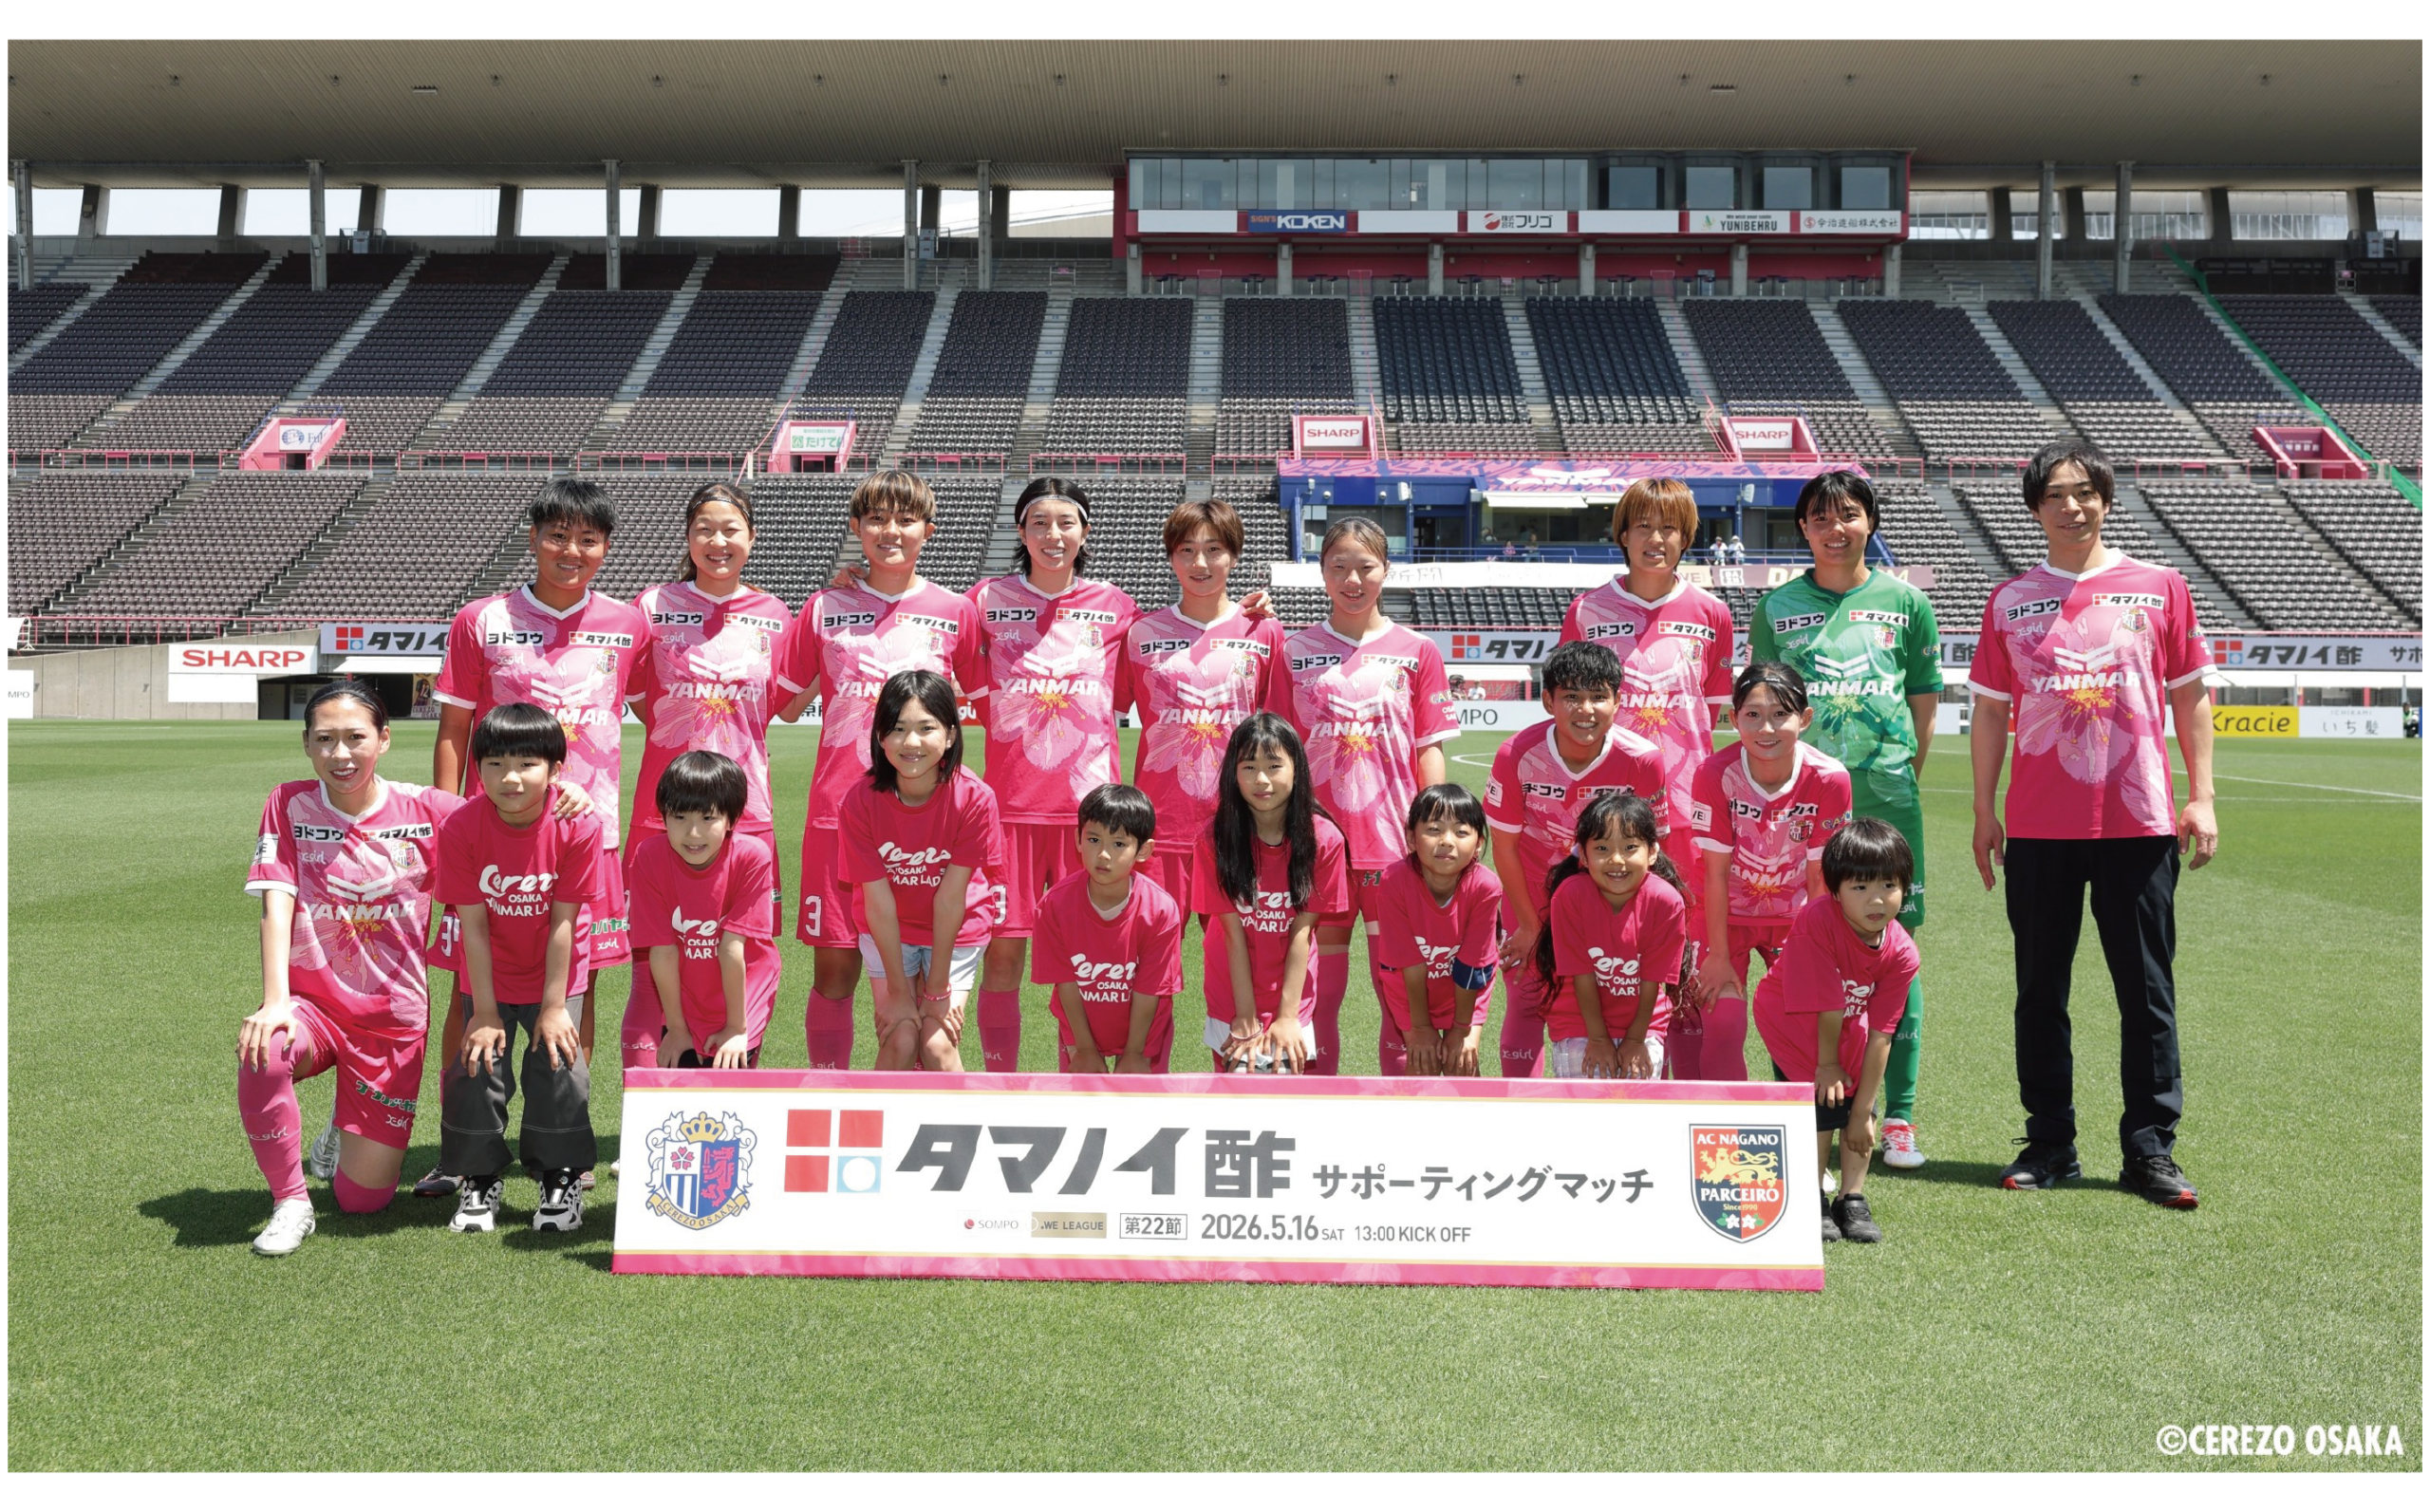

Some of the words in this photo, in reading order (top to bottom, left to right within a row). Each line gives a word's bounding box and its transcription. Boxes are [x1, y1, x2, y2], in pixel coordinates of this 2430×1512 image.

[1277, 215, 1345, 230] KOKEN
[1516, 215, 1553, 229] フリゴ
[1721, 220, 1778, 232] YUNIBEHRU
[1307, 428, 1360, 438] SHARP
[1735, 430, 1789, 439] SHARP
[2110, 595, 2163, 608] タマノイ酢
[986, 608, 1037, 622] ヨドコウ
[1072, 610, 1115, 624] タマノイ酢
[2007, 598, 2060, 621] ヨドコウ
[652, 613, 703, 625] ヨドコウ
[739, 616, 781, 630] タマノイ酢
[824, 612, 875, 627] ヨドコウ
[911, 617, 959, 633] タマノイ酢
[1775, 614, 1825, 633] ヨドコウ
[488, 632, 543, 645] ヨドコウ
[1587, 623, 1635, 640] ヨドコウ
[586, 633, 633, 647] タマノイ酢
[1140, 640, 1190, 655] ヨドコウ
[182, 649, 306, 668] SHARP
[1293, 655, 1341, 670] ヨドコウ
[2247, 645, 2364, 665] タマノイ酢
[836, 681, 884, 698] YAN
[999, 678, 1100, 696] YANMAR
[2031, 671, 2142, 694] YANMAR
[8, 690, 30, 699] MPO
[1618, 694, 1697, 709] ANMAR
[2213, 711, 2290, 733] Kracie
[2323, 719, 2380, 736] いち髪
[294, 825, 345, 841] ヨドコウ
[378, 826, 432, 839] タマノイ酢
[478, 864, 559, 898] Cerez
[508, 894, 543, 904] OSAKA
[306, 899, 417, 922] YANMAR
[804, 895, 822, 937] 3
[1256, 909, 1286, 920] OSAKA
[1096, 981, 1129, 991] OSAKA
[1079, 988, 1119, 1002] NMAR
[1696, 1133, 1716, 1145] AC
[1719, 1133, 1779, 1146] NAGANO
[895, 1124, 1296, 1199] タマノイ酢
[1312, 1164, 1654, 1204] サポーティングマッチ
[1700, 1187, 1780, 1203] PARCEIRO
[663, 1202, 697, 1227] CEREZO
[699, 1204, 735, 1227] OSAKA
[978, 1219, 1019, 1230] SOMPO
[1062, 1221, 1104, 1231] LEAGUE
[1125, 1216, 1182, 1236] 第22節
[1201, 1213, 1319, 1241] 2026.5.16
[1321, 1228, 1345, 1241] SAT
[1355, 1225, 1395, 1241] 13:00
[1398, 1226, 1436, 1242] KICK
[1440, 1226, 1472, 1242] OFF
